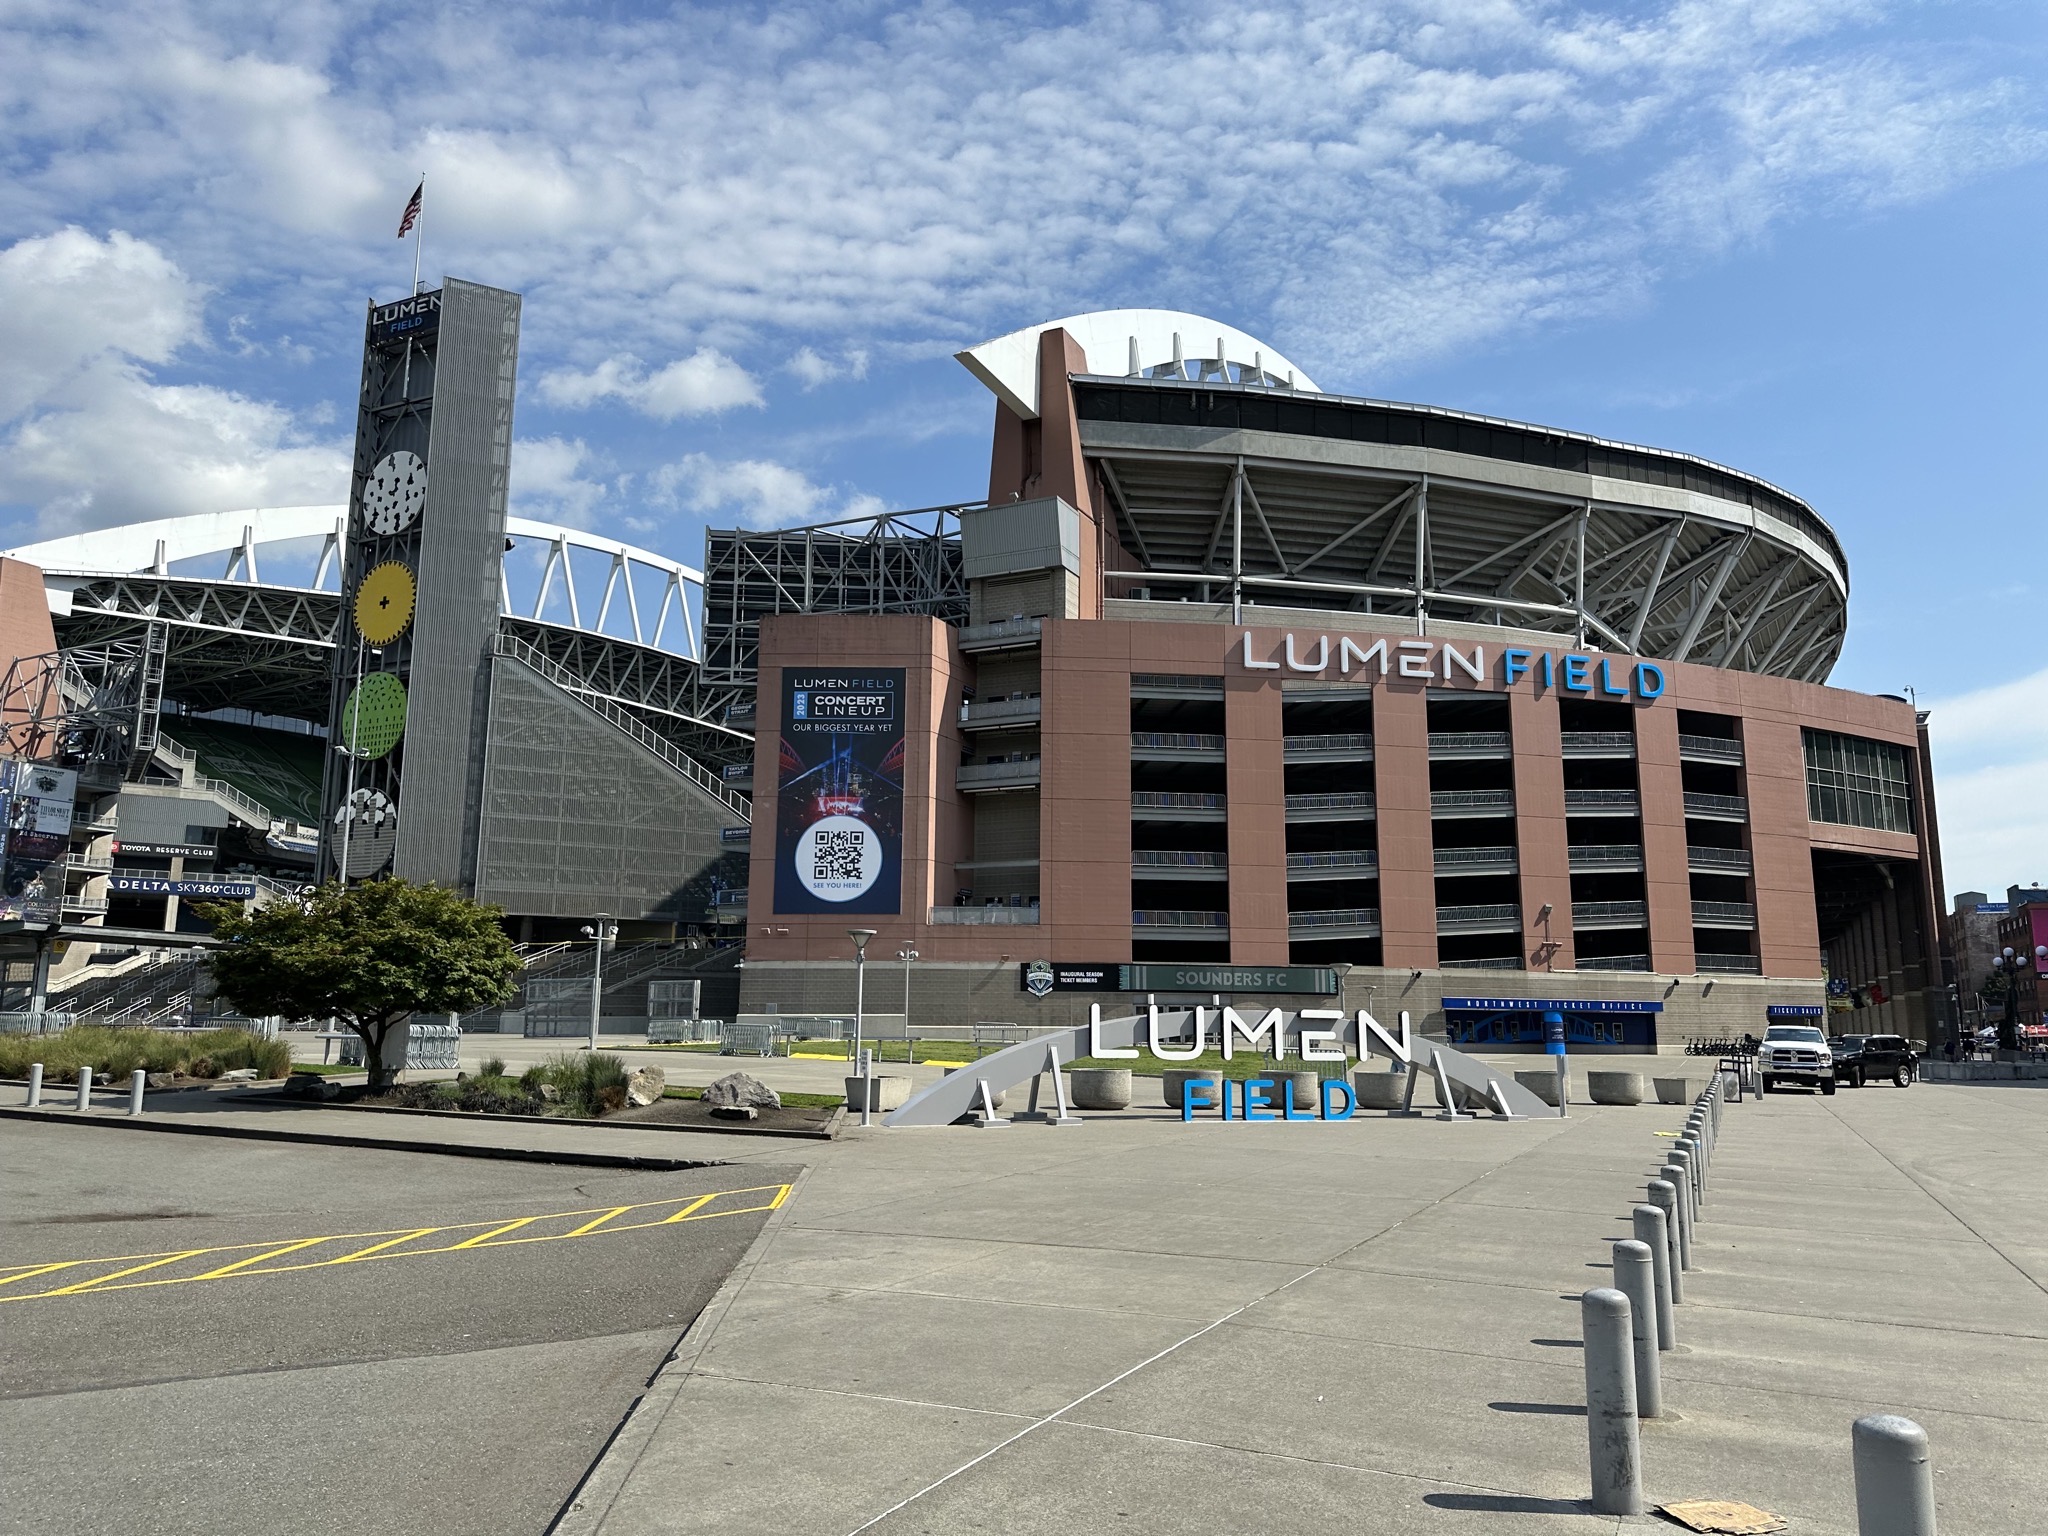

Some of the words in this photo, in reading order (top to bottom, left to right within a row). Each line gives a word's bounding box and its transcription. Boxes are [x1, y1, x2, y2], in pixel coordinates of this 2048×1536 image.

[373, 296, 441, 325] LUMEN
[390, 317, 423, 333] FIELD
[1243, 631, 1484, 682] LUMEN
[1504, 648, 1665, 698] FIELD
[794, 679, 848, 688] LUMEN
[852, 679, 894, 688] FIELD
[796, 694, 805, 715] 2023
[815, 696, 885, 705] CONCERT
[815, 706, 885, 715] LINEUP
[793, 723, 811, 732] OUR
[814, 723, 851, 732] BIGGEST
[853, 724, 875, 732] YEAR
[877, 724, 893, 732] YET
[156, 846, 190, 855] RESERVE
[119, 880, 171, 891] DELTA
[1176, 971, 1262, 986] SOUNDERS
[1266, 973, 1287, 986] FC
[1467, 1000, 1537, 1009] NORTHWEST
[1549, 1001, 1591, 1009] TICKET
[1602, 1002, 1642, 1010] OFFICE
[1088, 1003, 1412, 1062] LUMEN
[1182, 1079, 1356, 1121] FIELD
